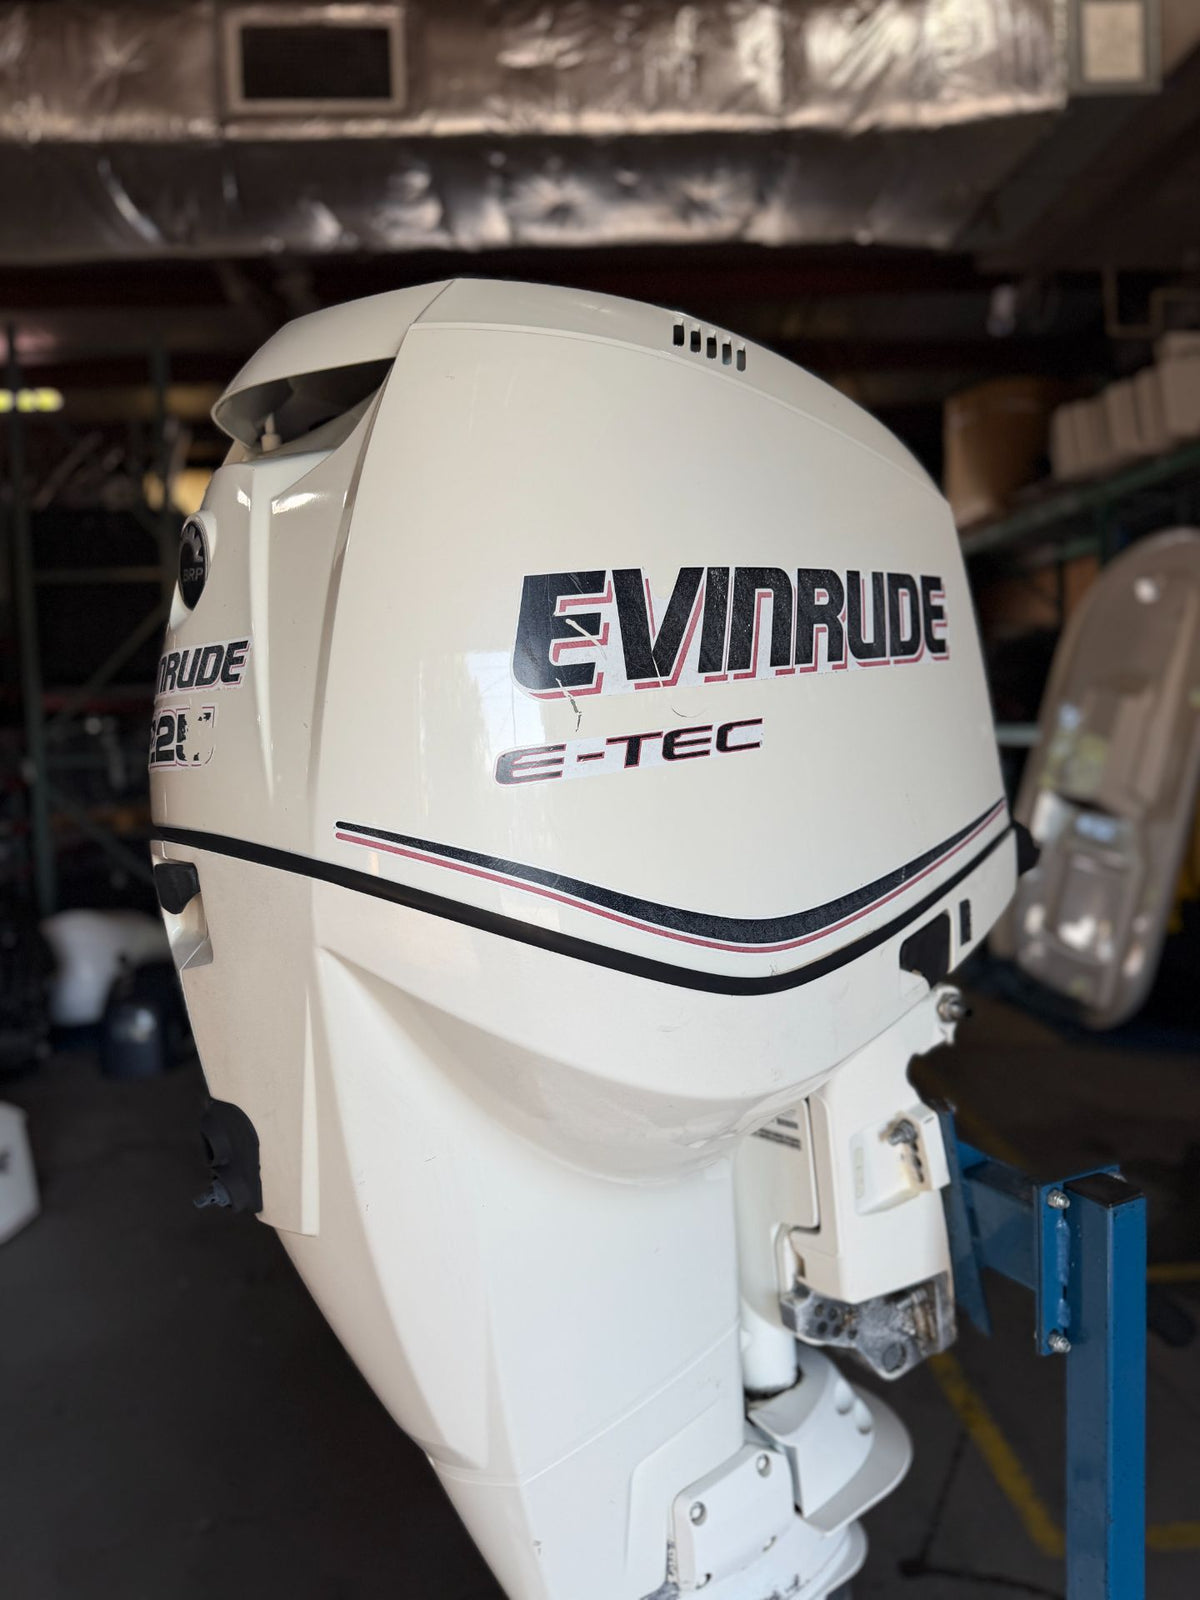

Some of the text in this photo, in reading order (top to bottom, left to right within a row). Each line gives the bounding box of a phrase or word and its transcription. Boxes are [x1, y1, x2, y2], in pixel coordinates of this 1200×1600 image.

[512, 567, 949, 698] EVINRUDE
[159, 640, 249, 695] NRUDE
[495, 718, 763, 785] E-TEC
